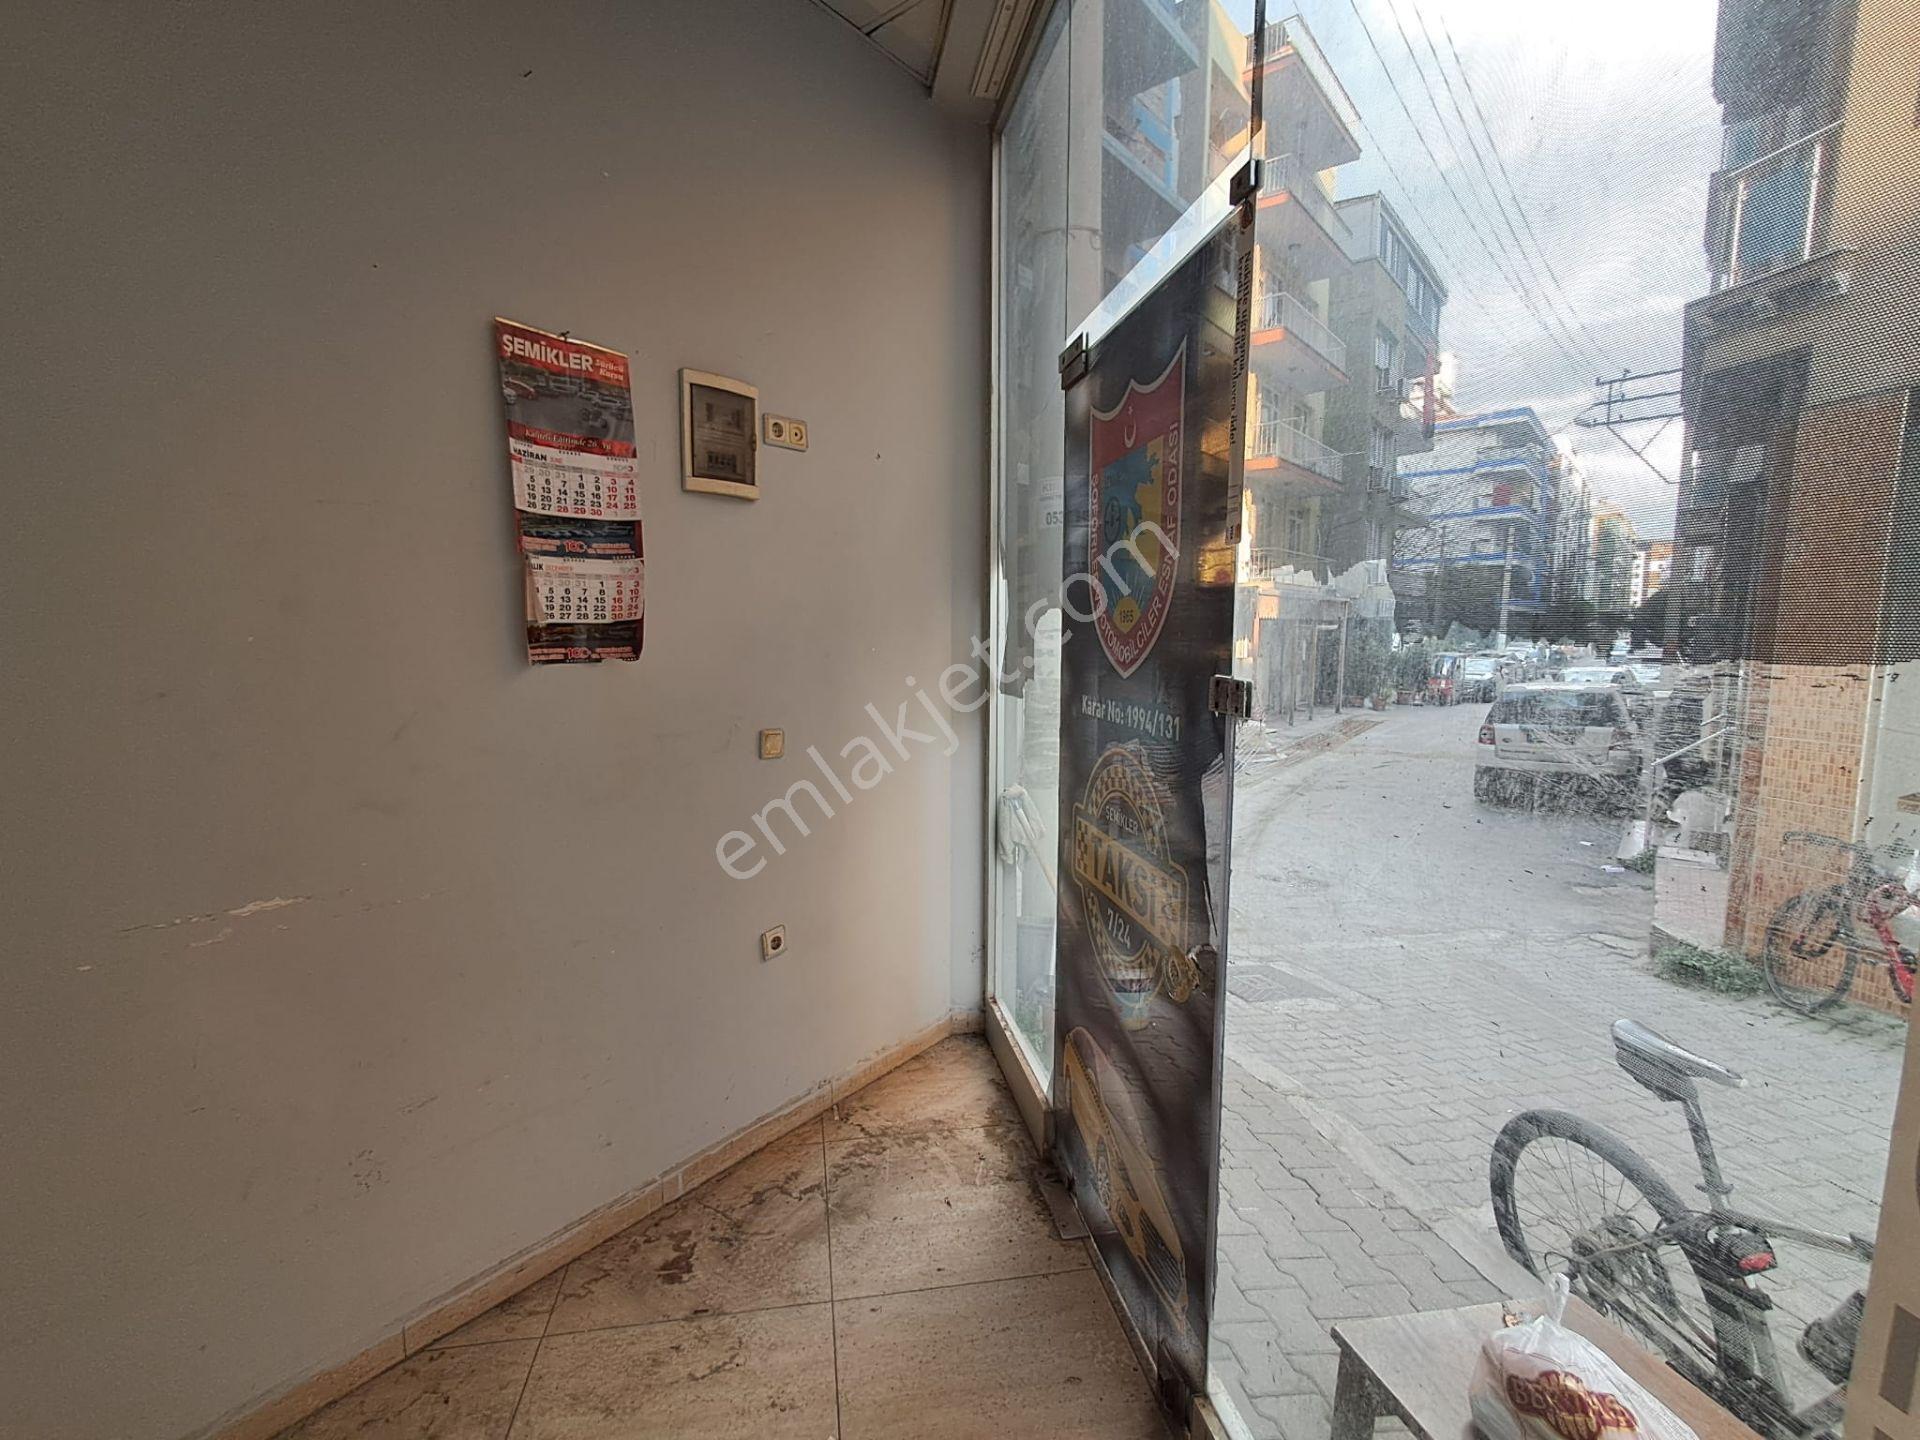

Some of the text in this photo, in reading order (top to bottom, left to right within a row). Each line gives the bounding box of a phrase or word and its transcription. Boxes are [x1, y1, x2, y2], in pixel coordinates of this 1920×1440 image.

[502, 334, 593, 372] ŞEMİKLER
[1168, 422, 1179, 506] ODASI
[527, 484, 536, 492] 12
[542, 486, 551, 494] 13
[592, 492, 601, 500] 16
[528, 492, 536, 500] 19
[528, 501, 537, 509] 26
[591, 508, 602, 516] 30
[1082, 694, 1106, 719] Karar
[1126, 705, 1180, 741] 1994/131
[1107, 907, 1131, 950] 7/24
